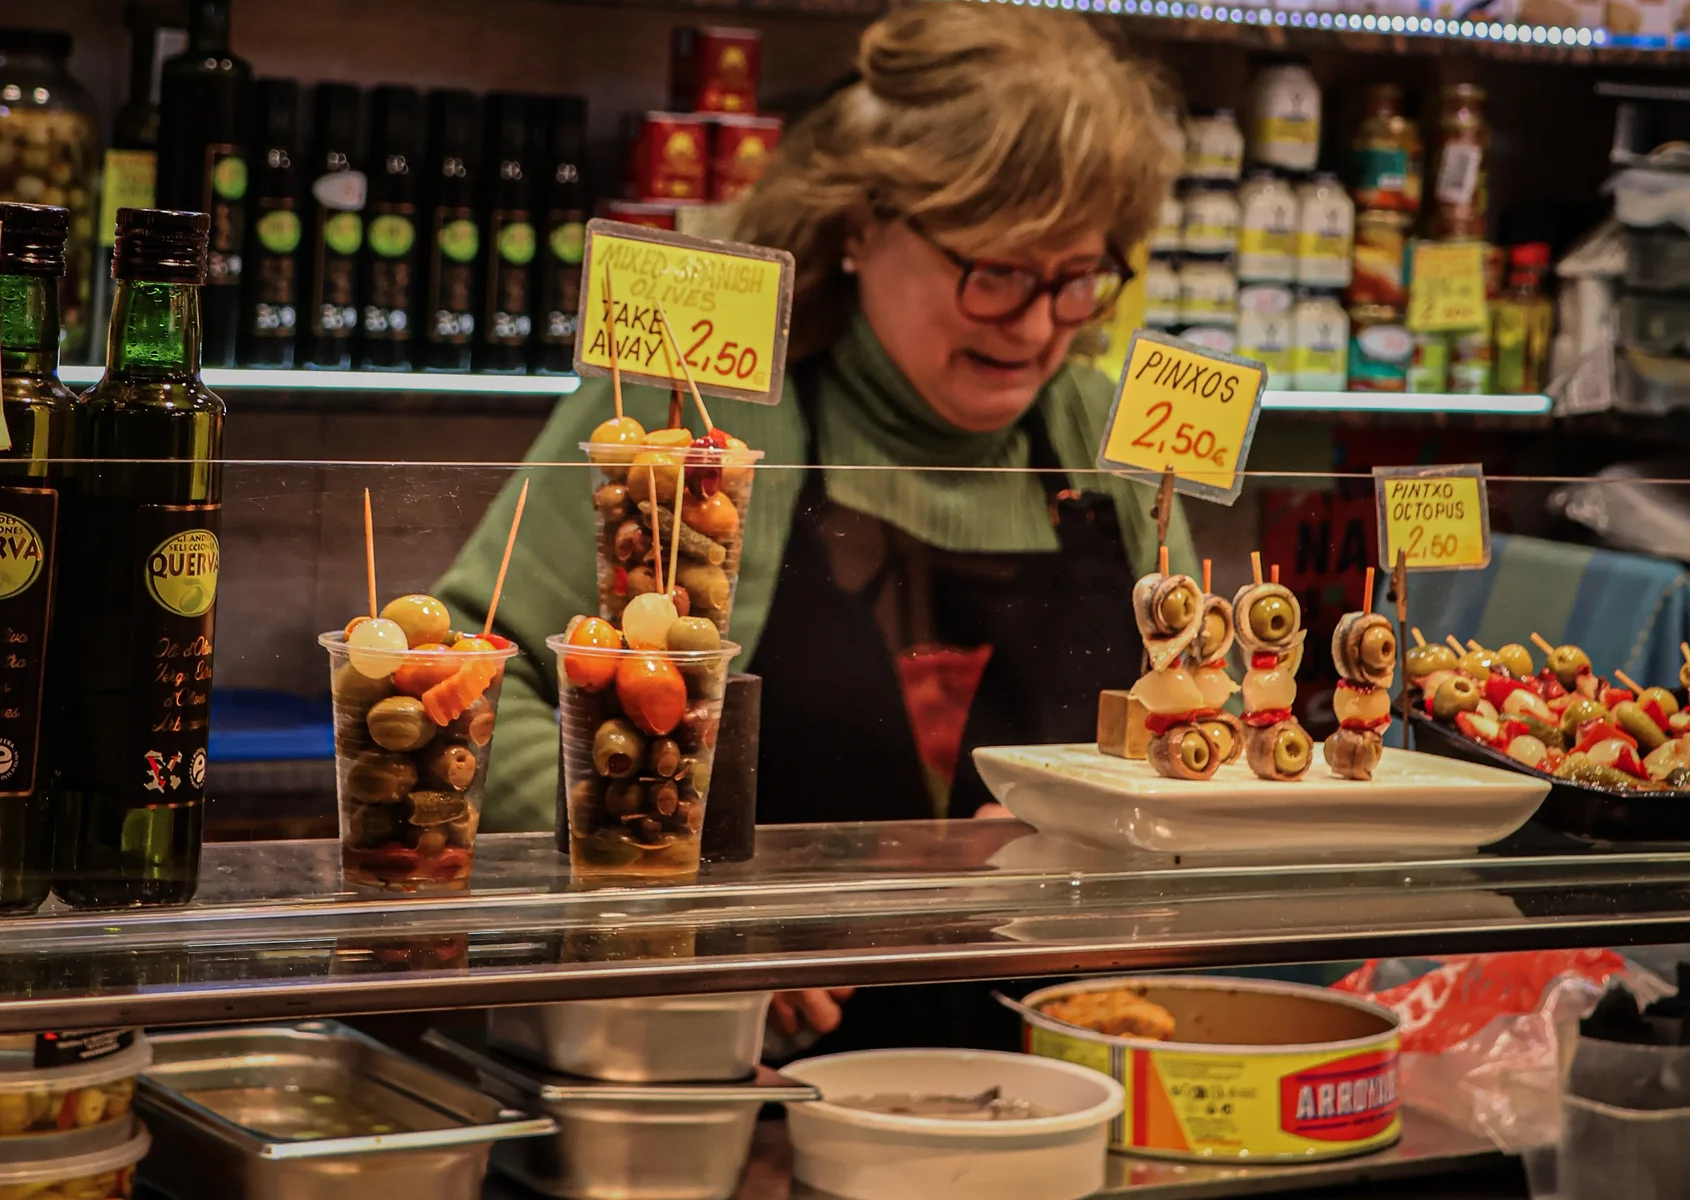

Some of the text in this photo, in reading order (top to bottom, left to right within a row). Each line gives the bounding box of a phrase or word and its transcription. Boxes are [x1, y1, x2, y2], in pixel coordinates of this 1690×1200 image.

[598, 243, 766, 294] MIXED SPANISH
[630, 278, 717, 312] OLIVES
[602, 299, 667, 336] TAKE
[589, 329, 663, 368] AWAY
[675, 319, 758, 380] 2,50
[1135, 351, 1240, 404] PINXOS
[1391, 482, 1454, 500] PINTXO
[1393, 501, 1465, 522] OCTOPUS
[147, 552, 219, 580] QUERVA
